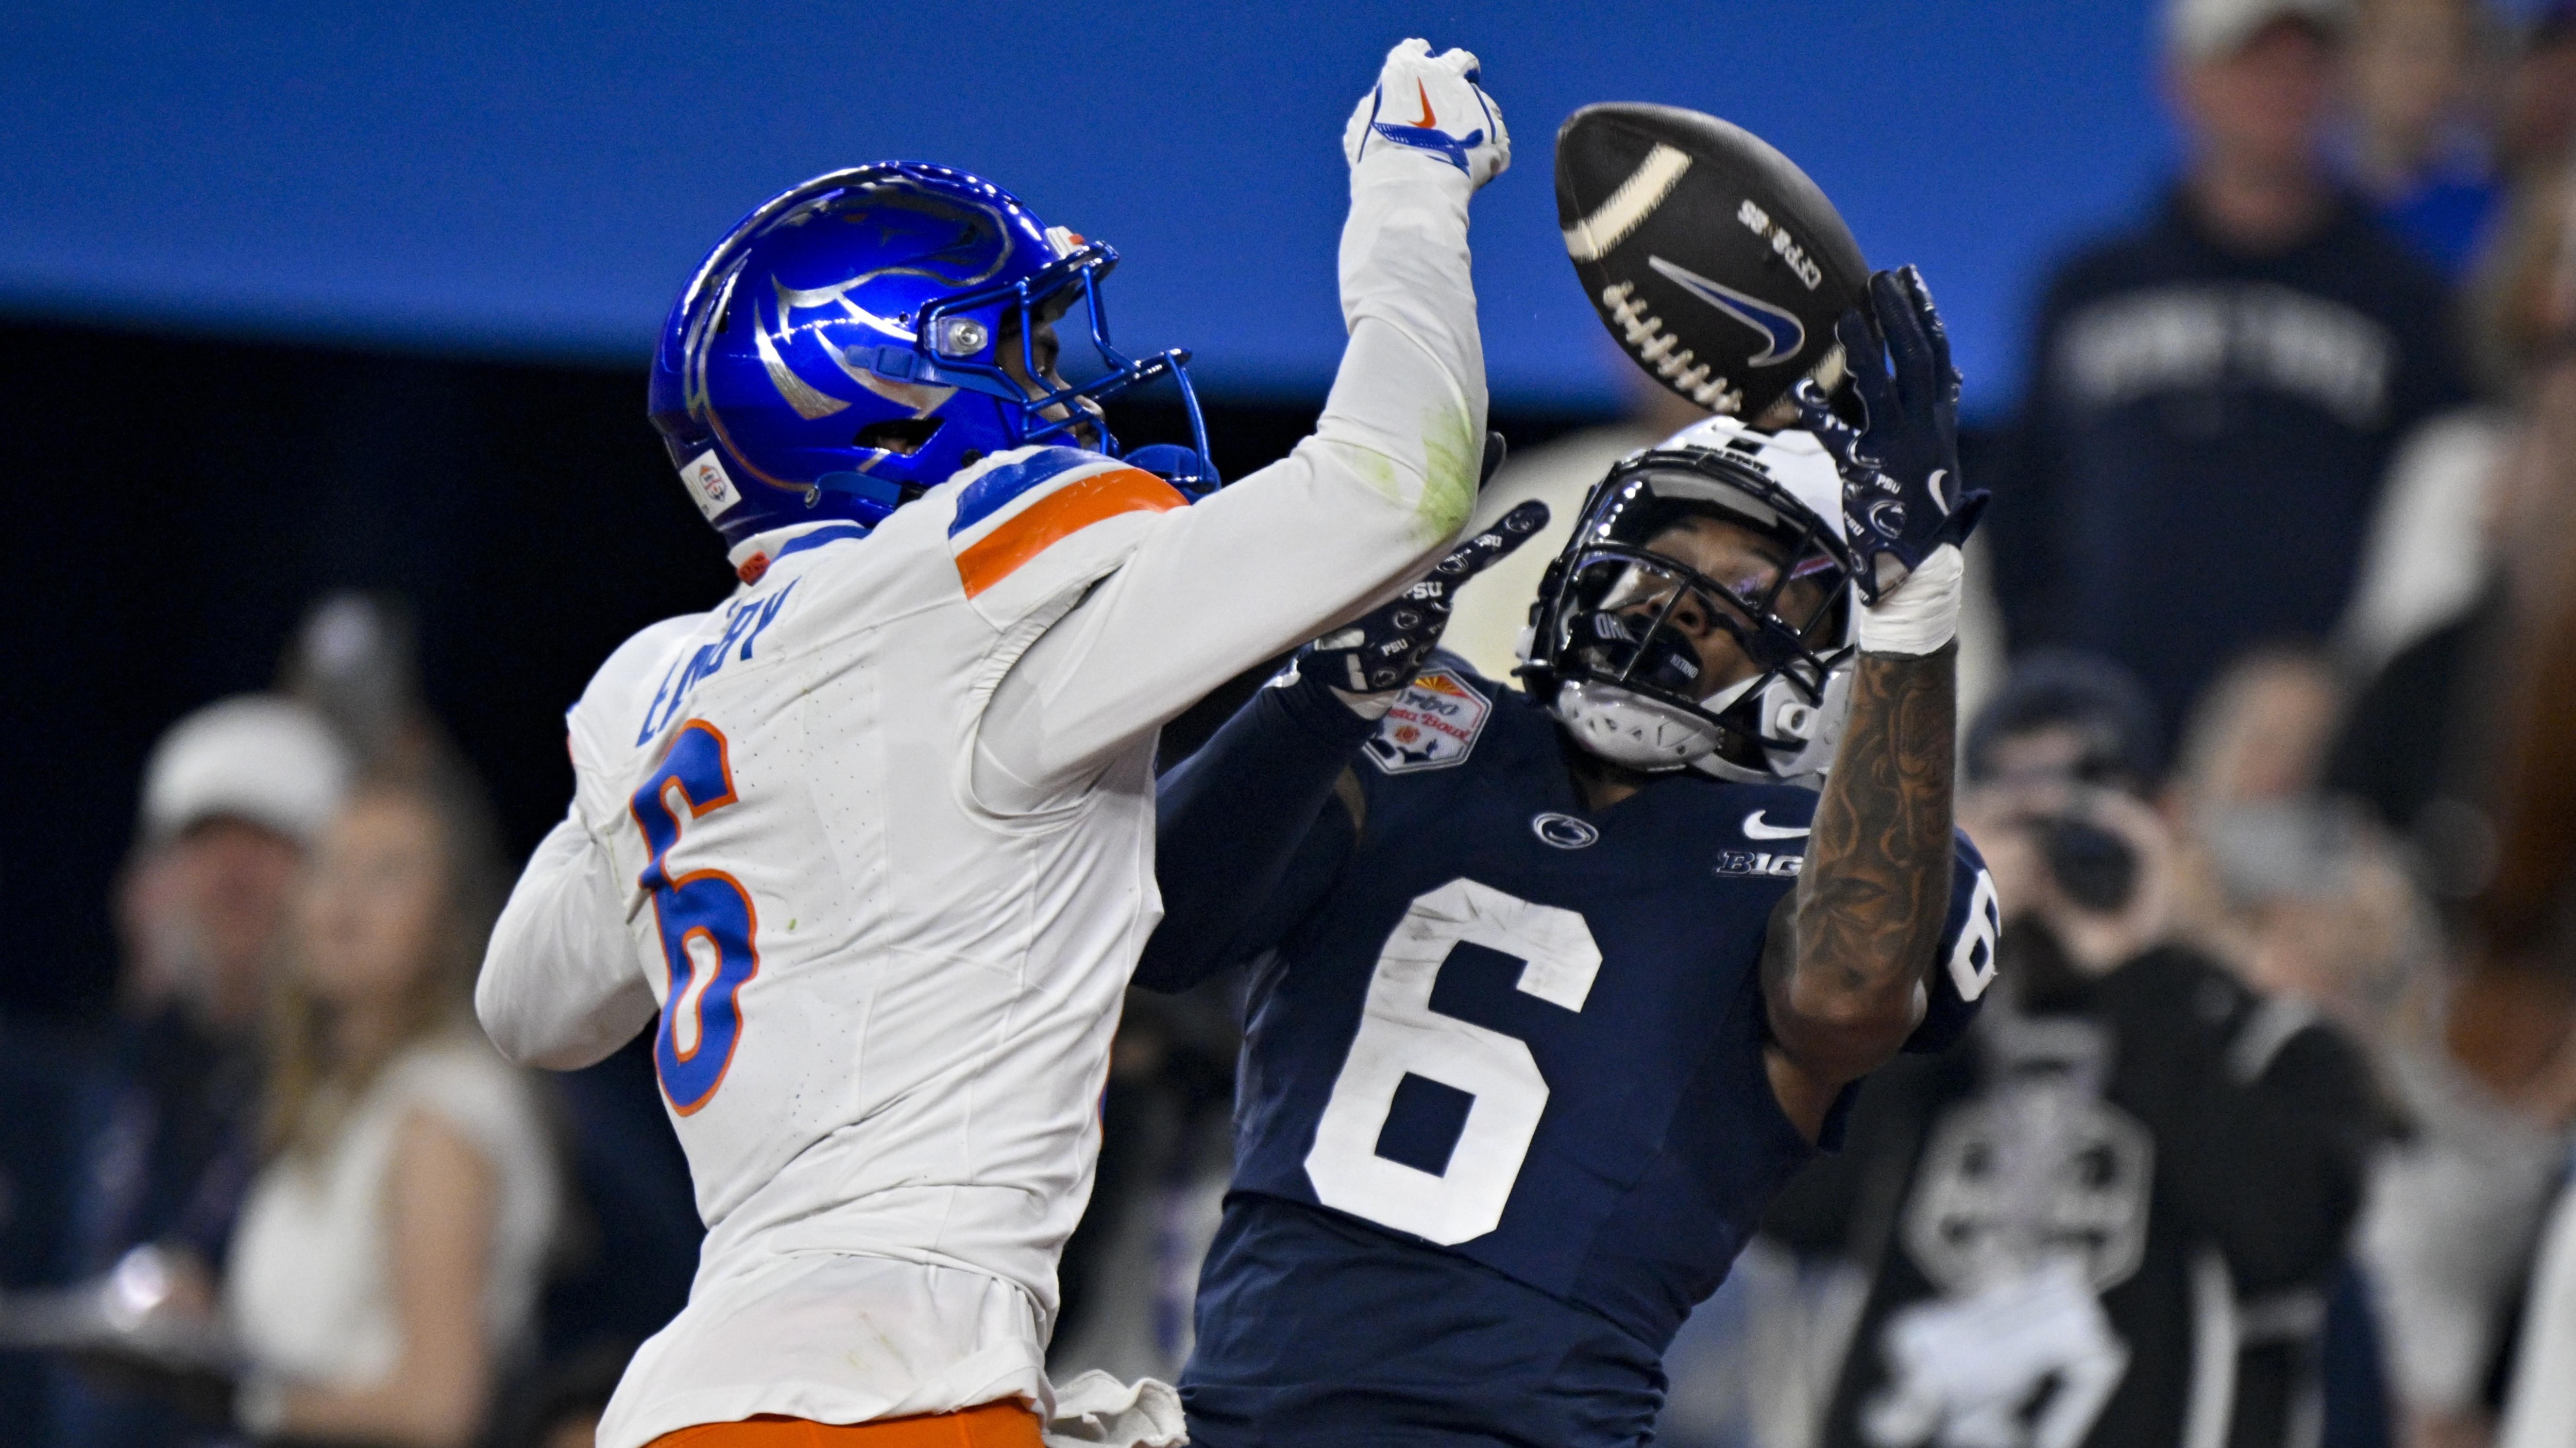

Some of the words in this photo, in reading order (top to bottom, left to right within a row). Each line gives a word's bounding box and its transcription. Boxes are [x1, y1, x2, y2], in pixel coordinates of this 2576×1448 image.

[1381, 638, 1408, 656] PSU
[630, 718, 759, 1117] 6
[1304, 877, 1603, 1247] 6
